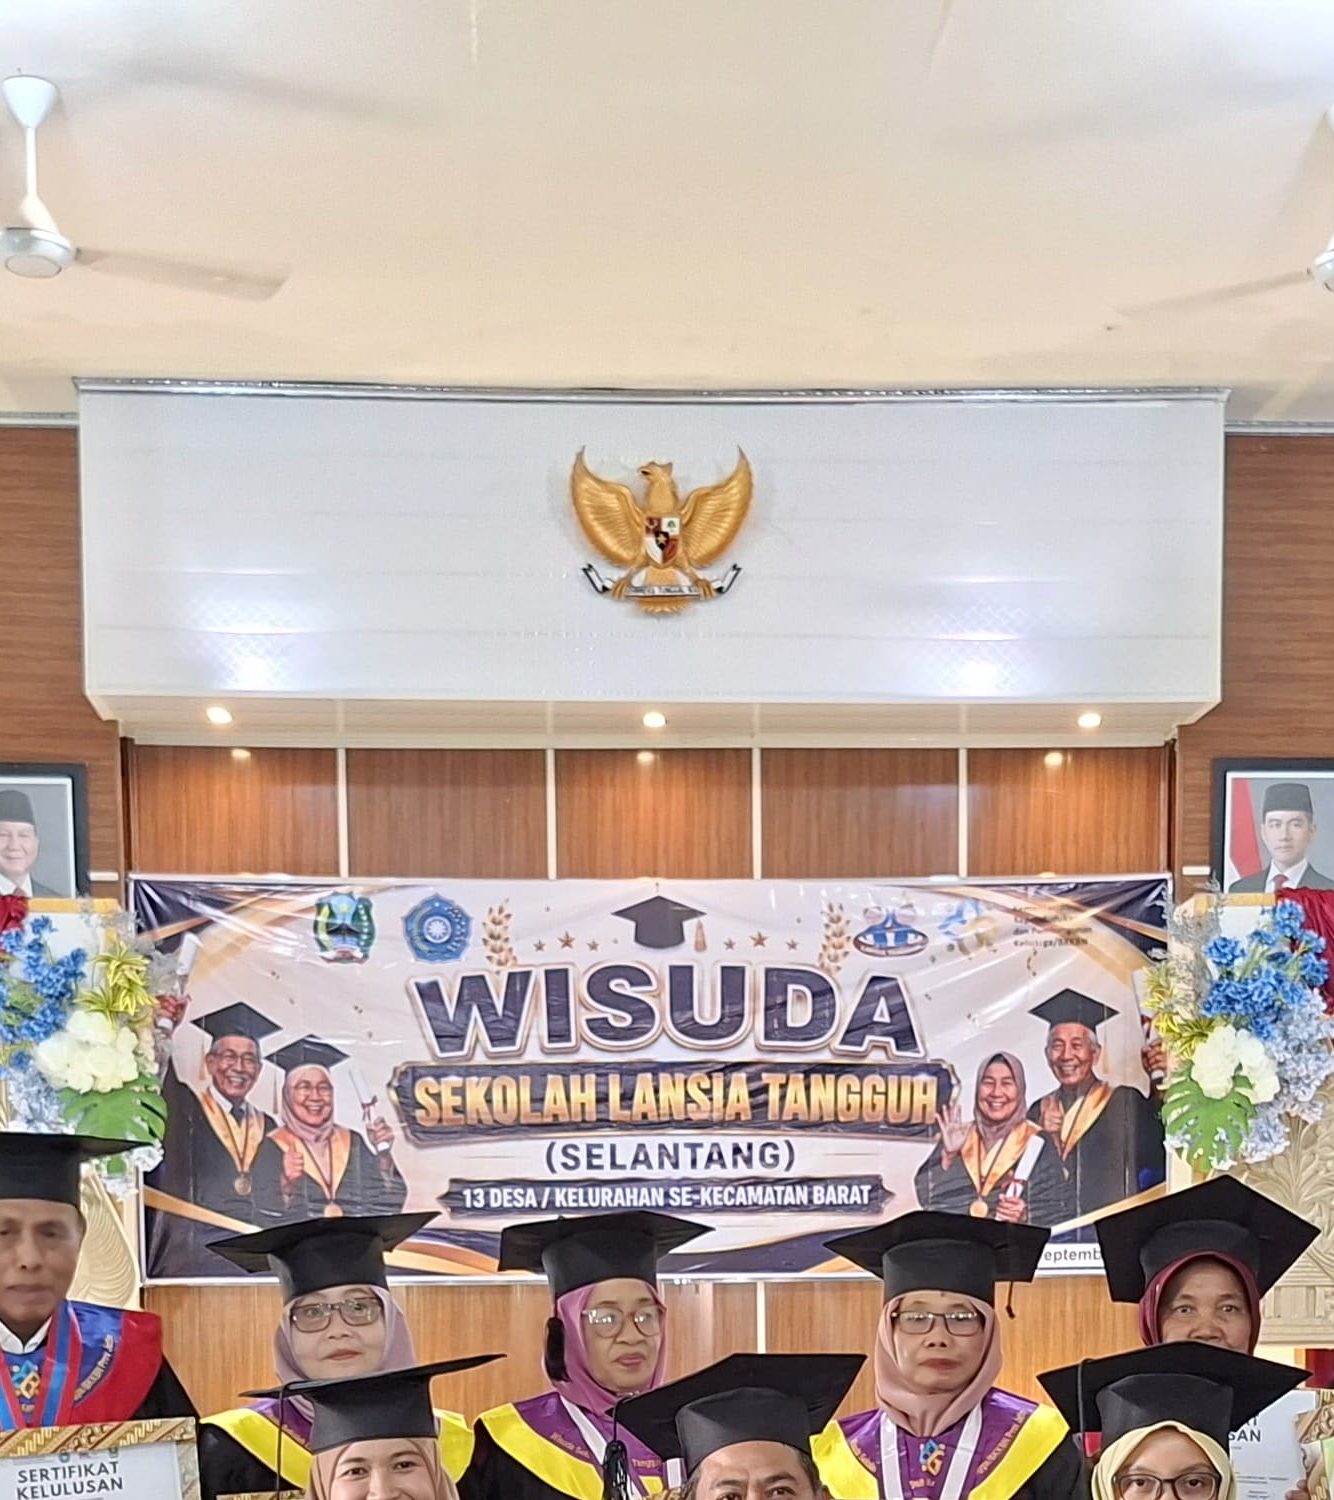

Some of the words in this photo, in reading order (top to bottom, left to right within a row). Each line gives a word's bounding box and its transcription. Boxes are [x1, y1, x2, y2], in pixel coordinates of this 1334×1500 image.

[413, 964, 924, 1056] WISUDA
[414, 1074, 589, 1127] SEKOLAH
[607, 1074, 745, 1123] LANSIA
[762, 1073, 939, 1124] TANGGUH
[545, 1139, 796, 1173] (SELANTANG)
[463, 1188, 486, 1208] 13
[489, 1188, 537, 1209] DESA
[541, 1187, 551, 1208] /
[554, 1187, 665, 1208] KELURAHAN
[668, 1186, 810, 1207] SE-KECAMATAN
[812, 1184, 871, 1206] BARAT
[1044, 1247, 1103, 1263] eptemb
[18, 1461, 119, 1483] SERTIFIKAT
[17, 1477, 123, 1500] KELULUSAN
